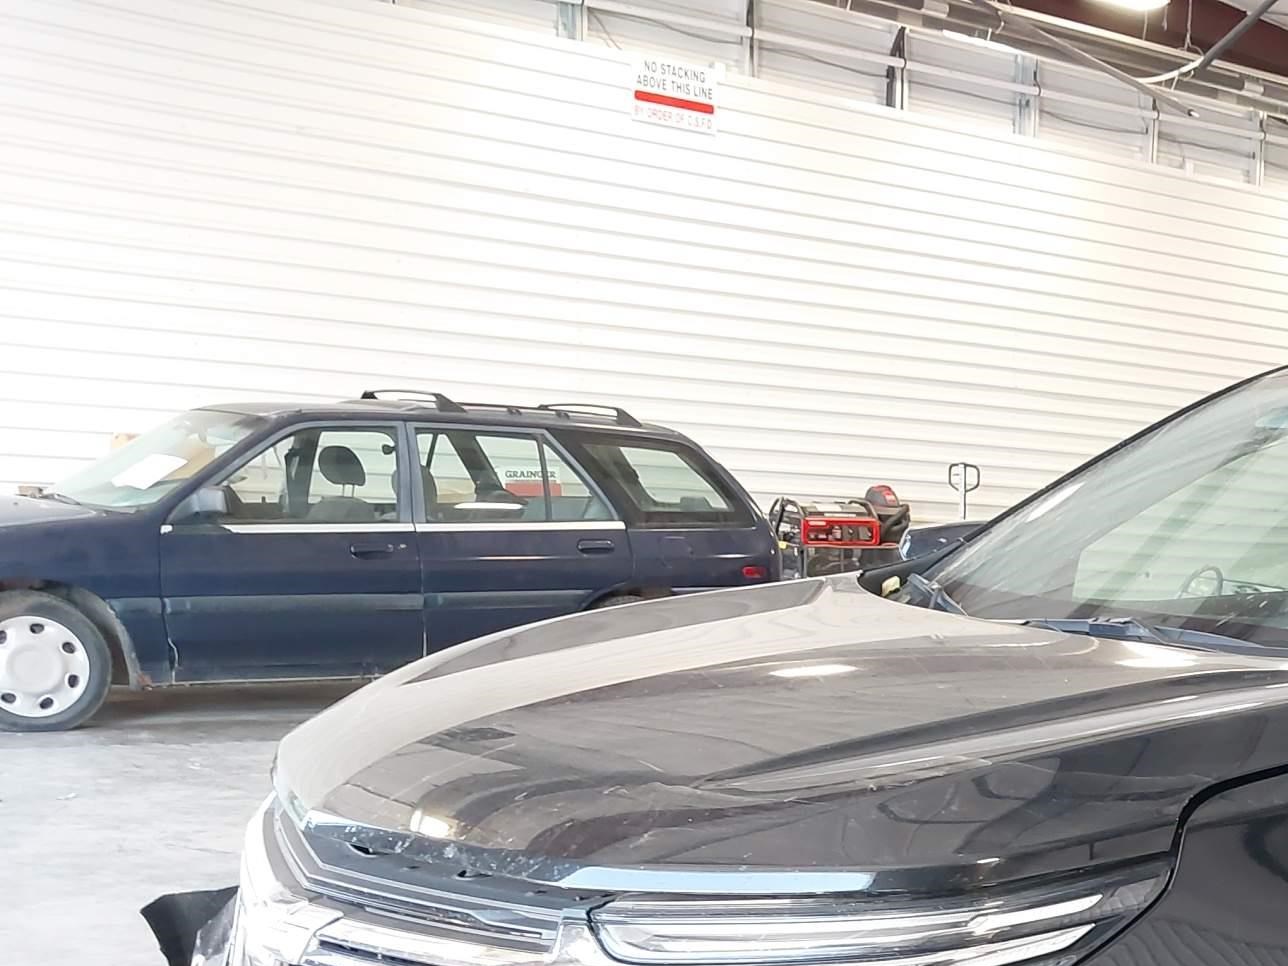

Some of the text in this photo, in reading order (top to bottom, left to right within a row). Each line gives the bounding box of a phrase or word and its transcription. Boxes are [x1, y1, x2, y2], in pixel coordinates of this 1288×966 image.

[644, 60, 706, 84] NO STACKING
[636, 74, 713, 100] ABOVE THIS LINE
